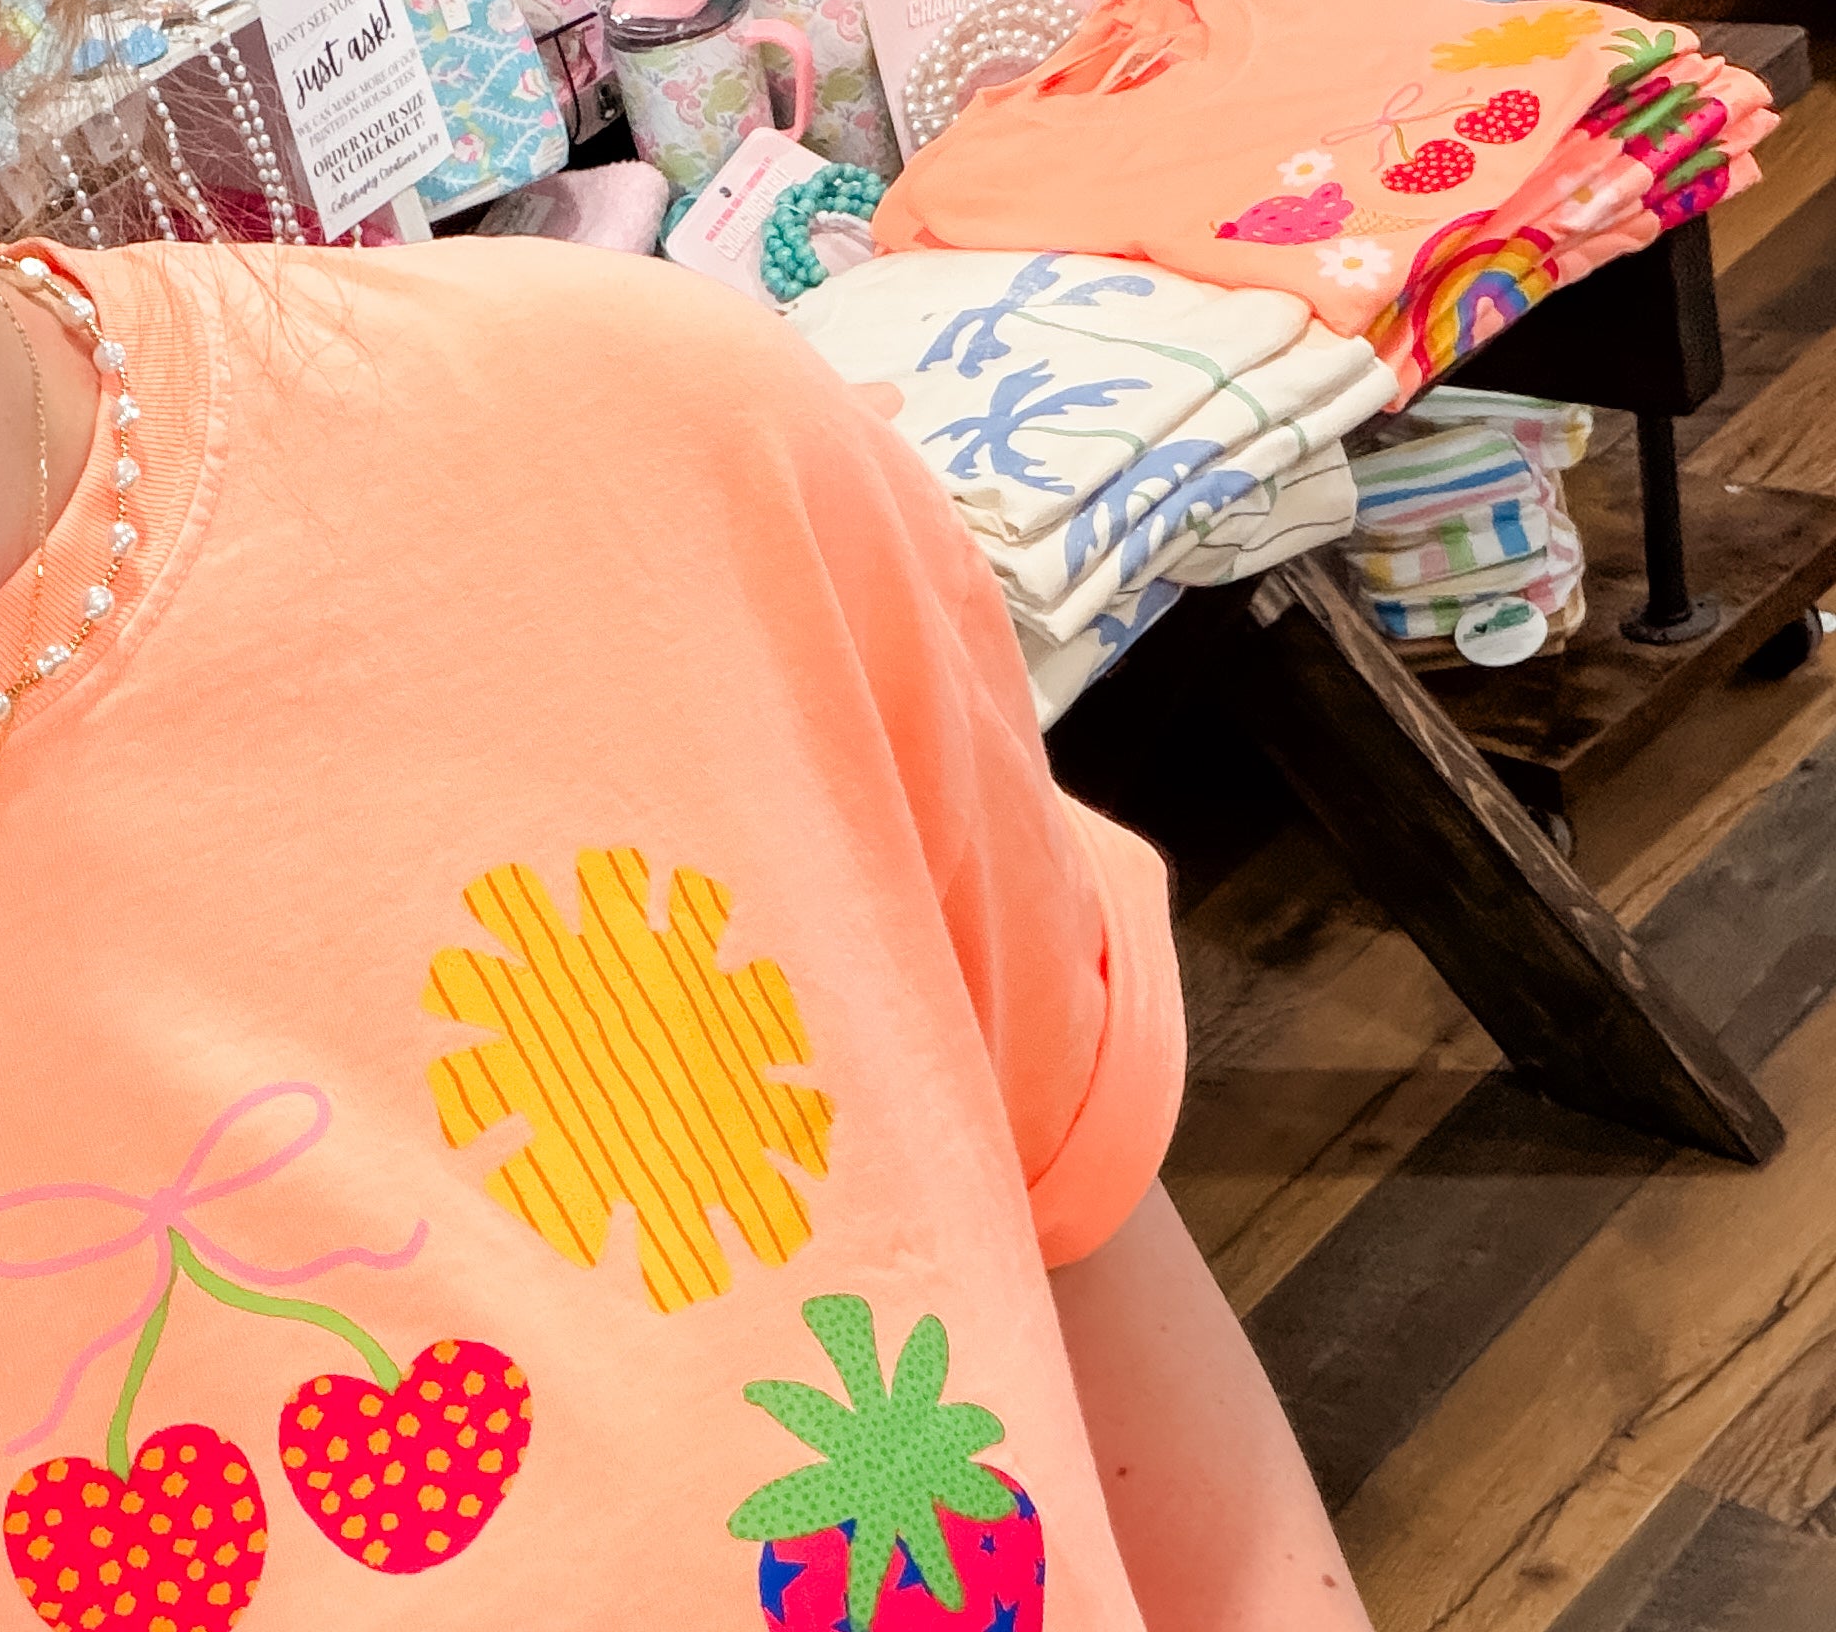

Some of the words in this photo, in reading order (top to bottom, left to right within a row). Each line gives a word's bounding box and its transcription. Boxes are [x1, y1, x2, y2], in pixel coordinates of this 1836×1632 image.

[306, 7, 331, 32] SEE
[292, 38, 344, 110] just
[359, 74, 386, 95] MORE
[360, 88, 395, 112] HOUSE
[313, 135, 361, 178] ORDER
[359, 109, 402, 146] YOUR
[399, 89, 426, 118] SIZE
[331, 162, 348, 184] AT
[348, 111, 426, 174] CHECKOUT!
